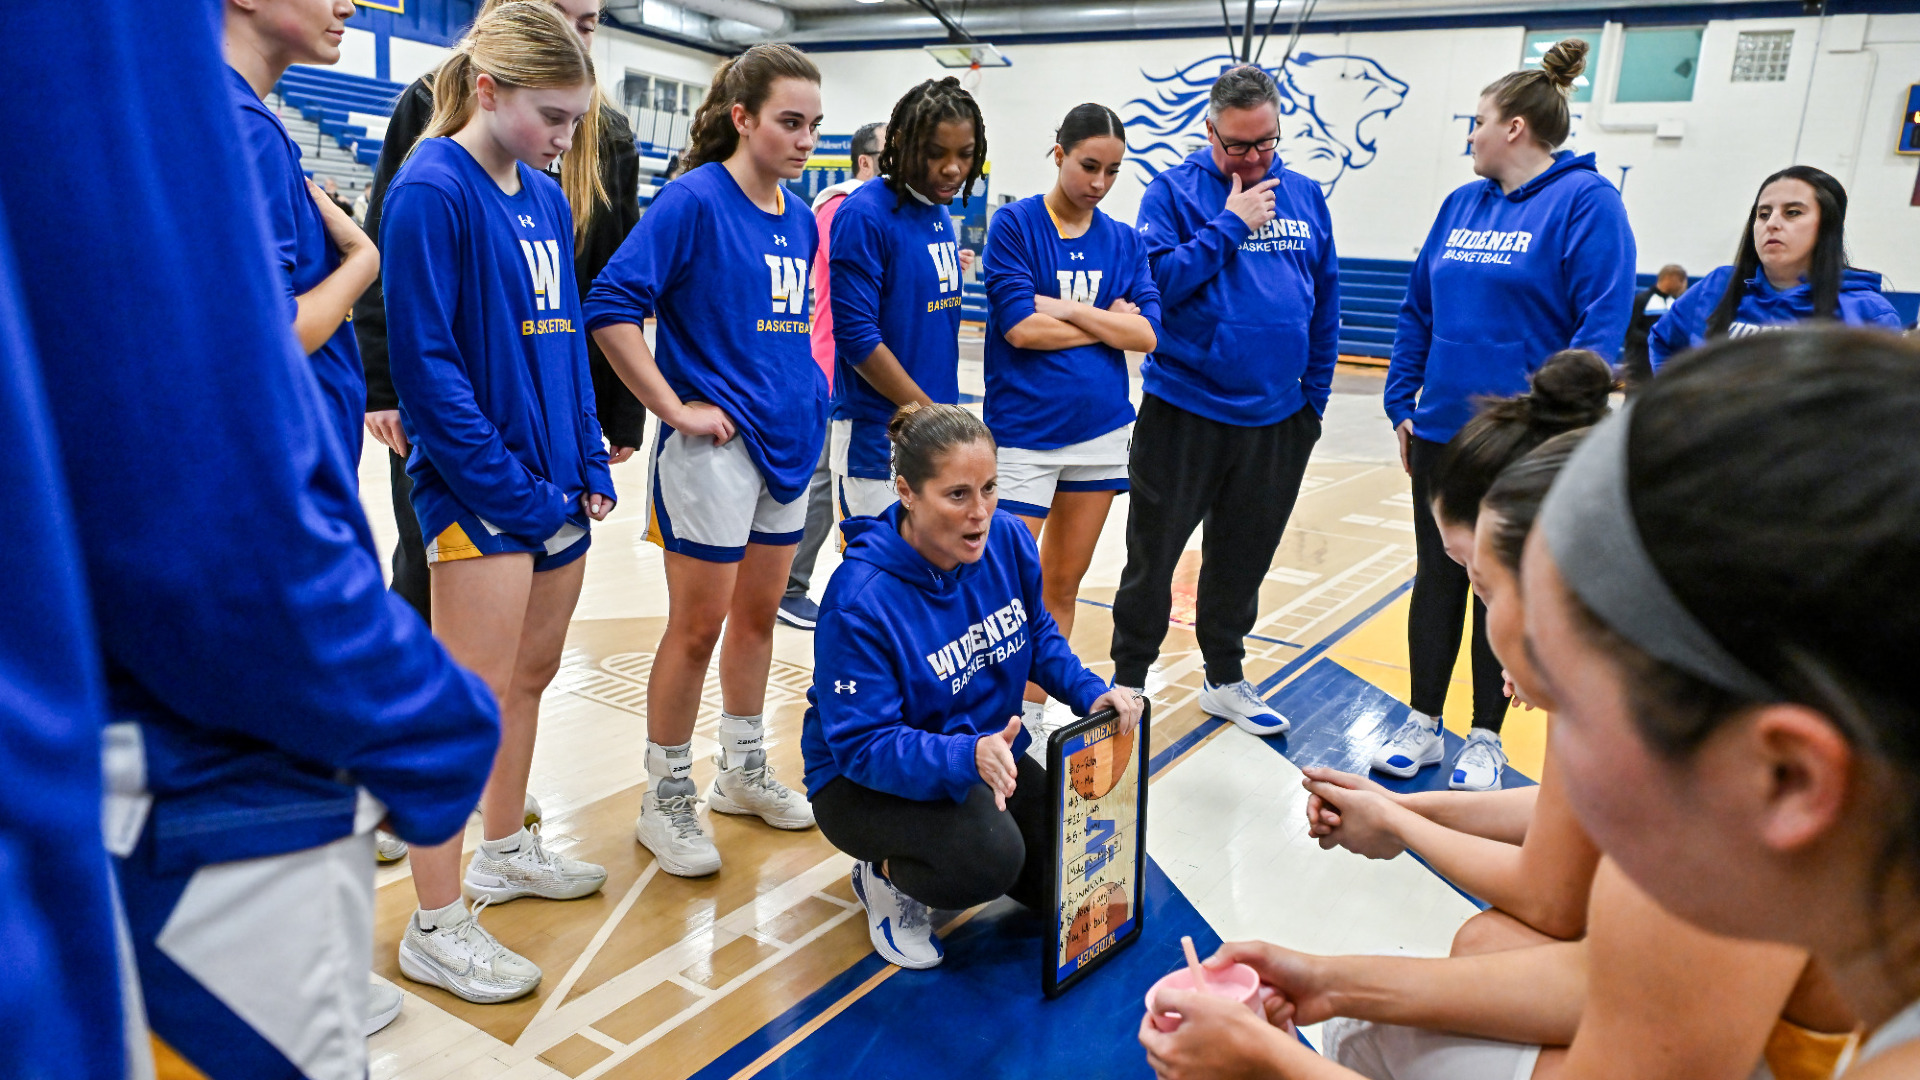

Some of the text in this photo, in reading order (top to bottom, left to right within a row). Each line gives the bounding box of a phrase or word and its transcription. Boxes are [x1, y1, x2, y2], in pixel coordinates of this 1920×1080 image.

[927, 241, 959, 293] W
[1442, 249, 1512, 265] BASKETBALL
[1445, 228, 1533, 253] WIDENER
[520, 239, 560, 310] W
[764, 253, 807, 314] W
[926, 598, 1028, 681] WIDENER
[951, 632, 1026, 695] BASKETBALL
[1083, 719, 1120, 747] WIDENE
